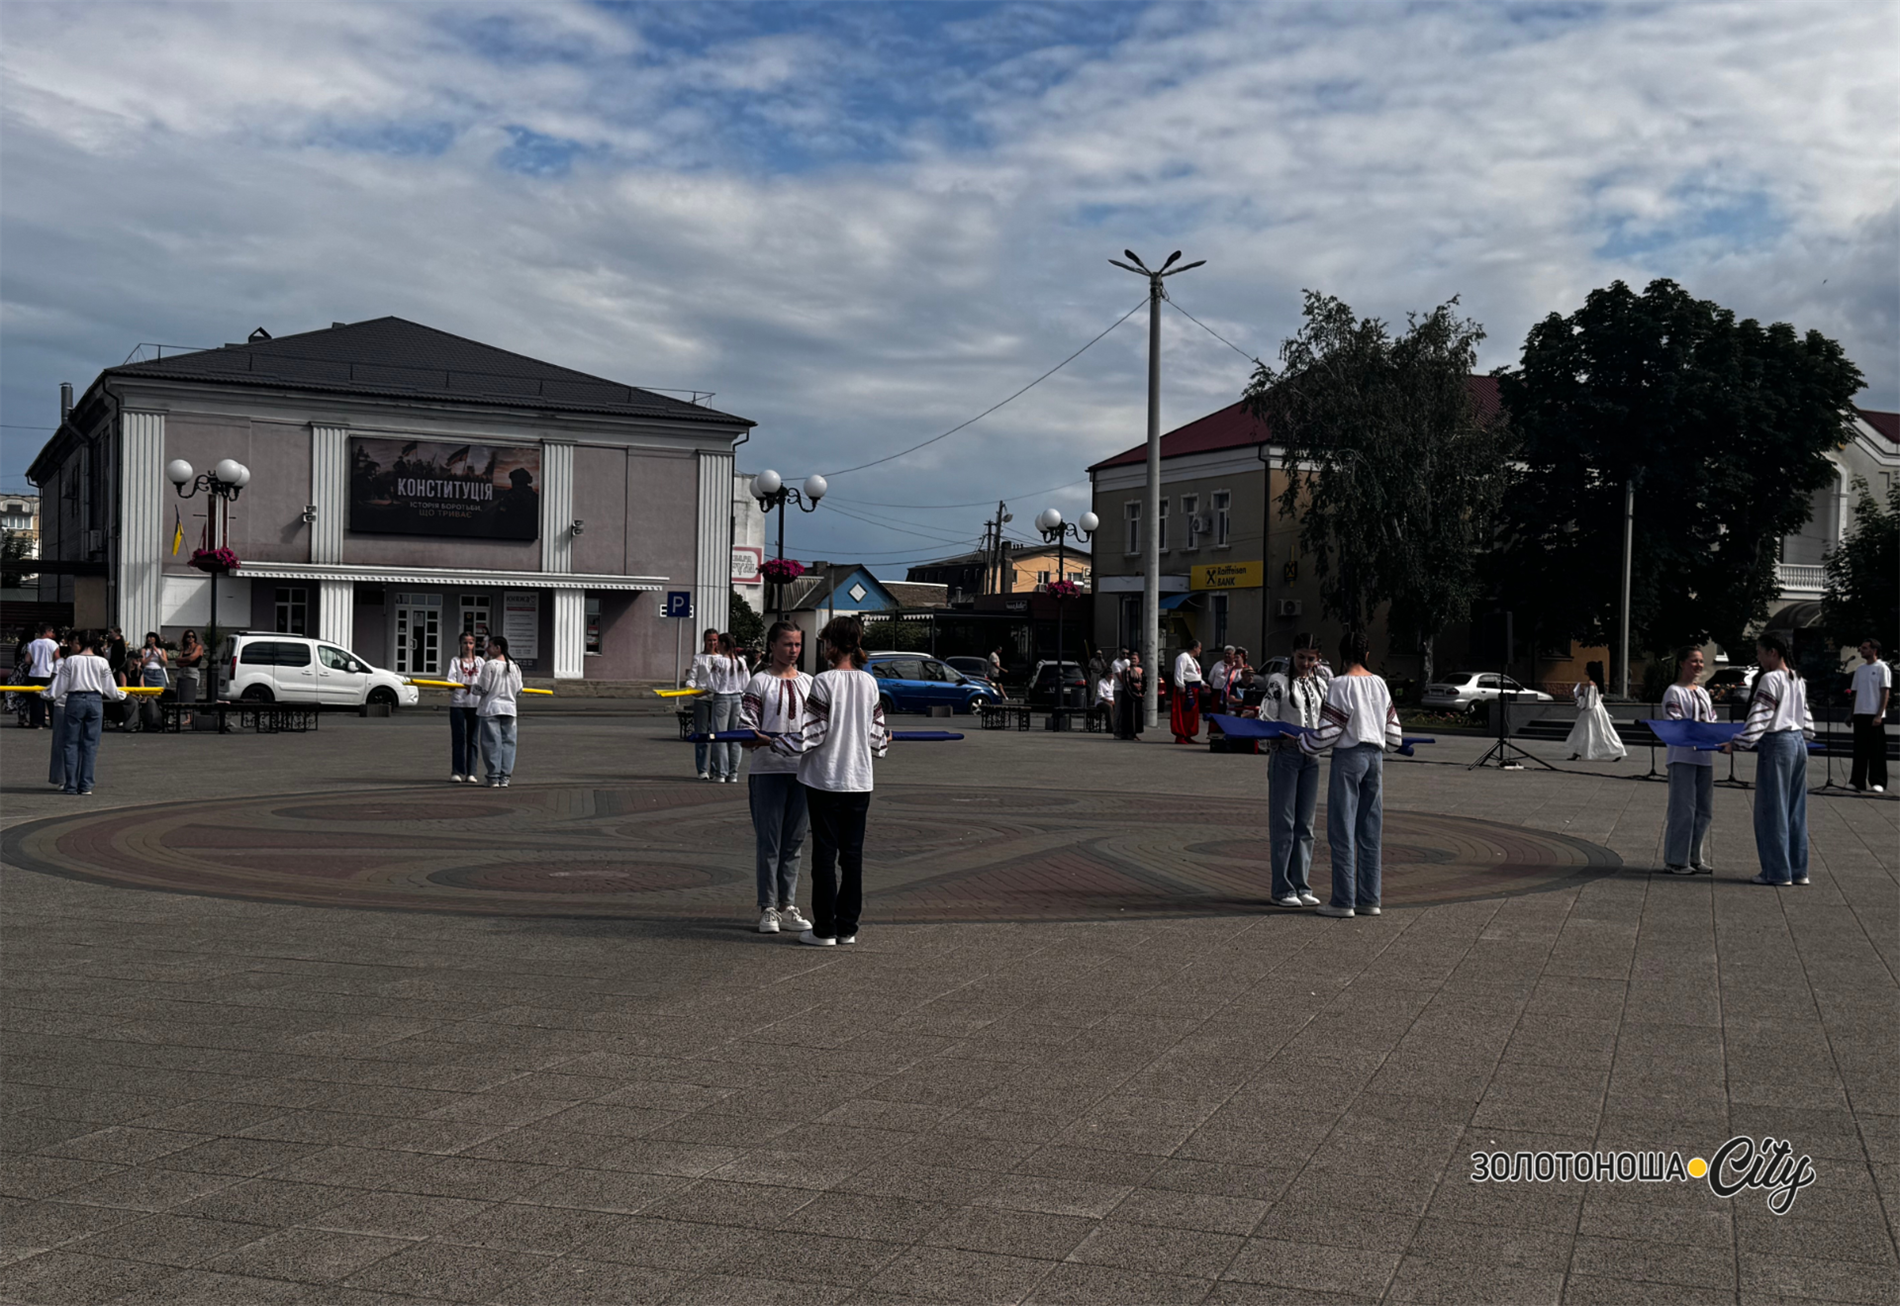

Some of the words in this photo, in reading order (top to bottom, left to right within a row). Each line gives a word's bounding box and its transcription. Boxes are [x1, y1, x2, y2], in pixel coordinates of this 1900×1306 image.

[397, 478, 493, 501] КОНСТИТУЦІЯ
[410, 501, 439, 509] ІСТОРІЯ
[419, 509, 435, 517] ЩО
[438, 510, 472, 518] ТРИВАЄ
[1217, 565, 1247, 575] Raiffeisen
[1217, 577, 1235, 586] BANK
[673, 596, 685, 613] P
